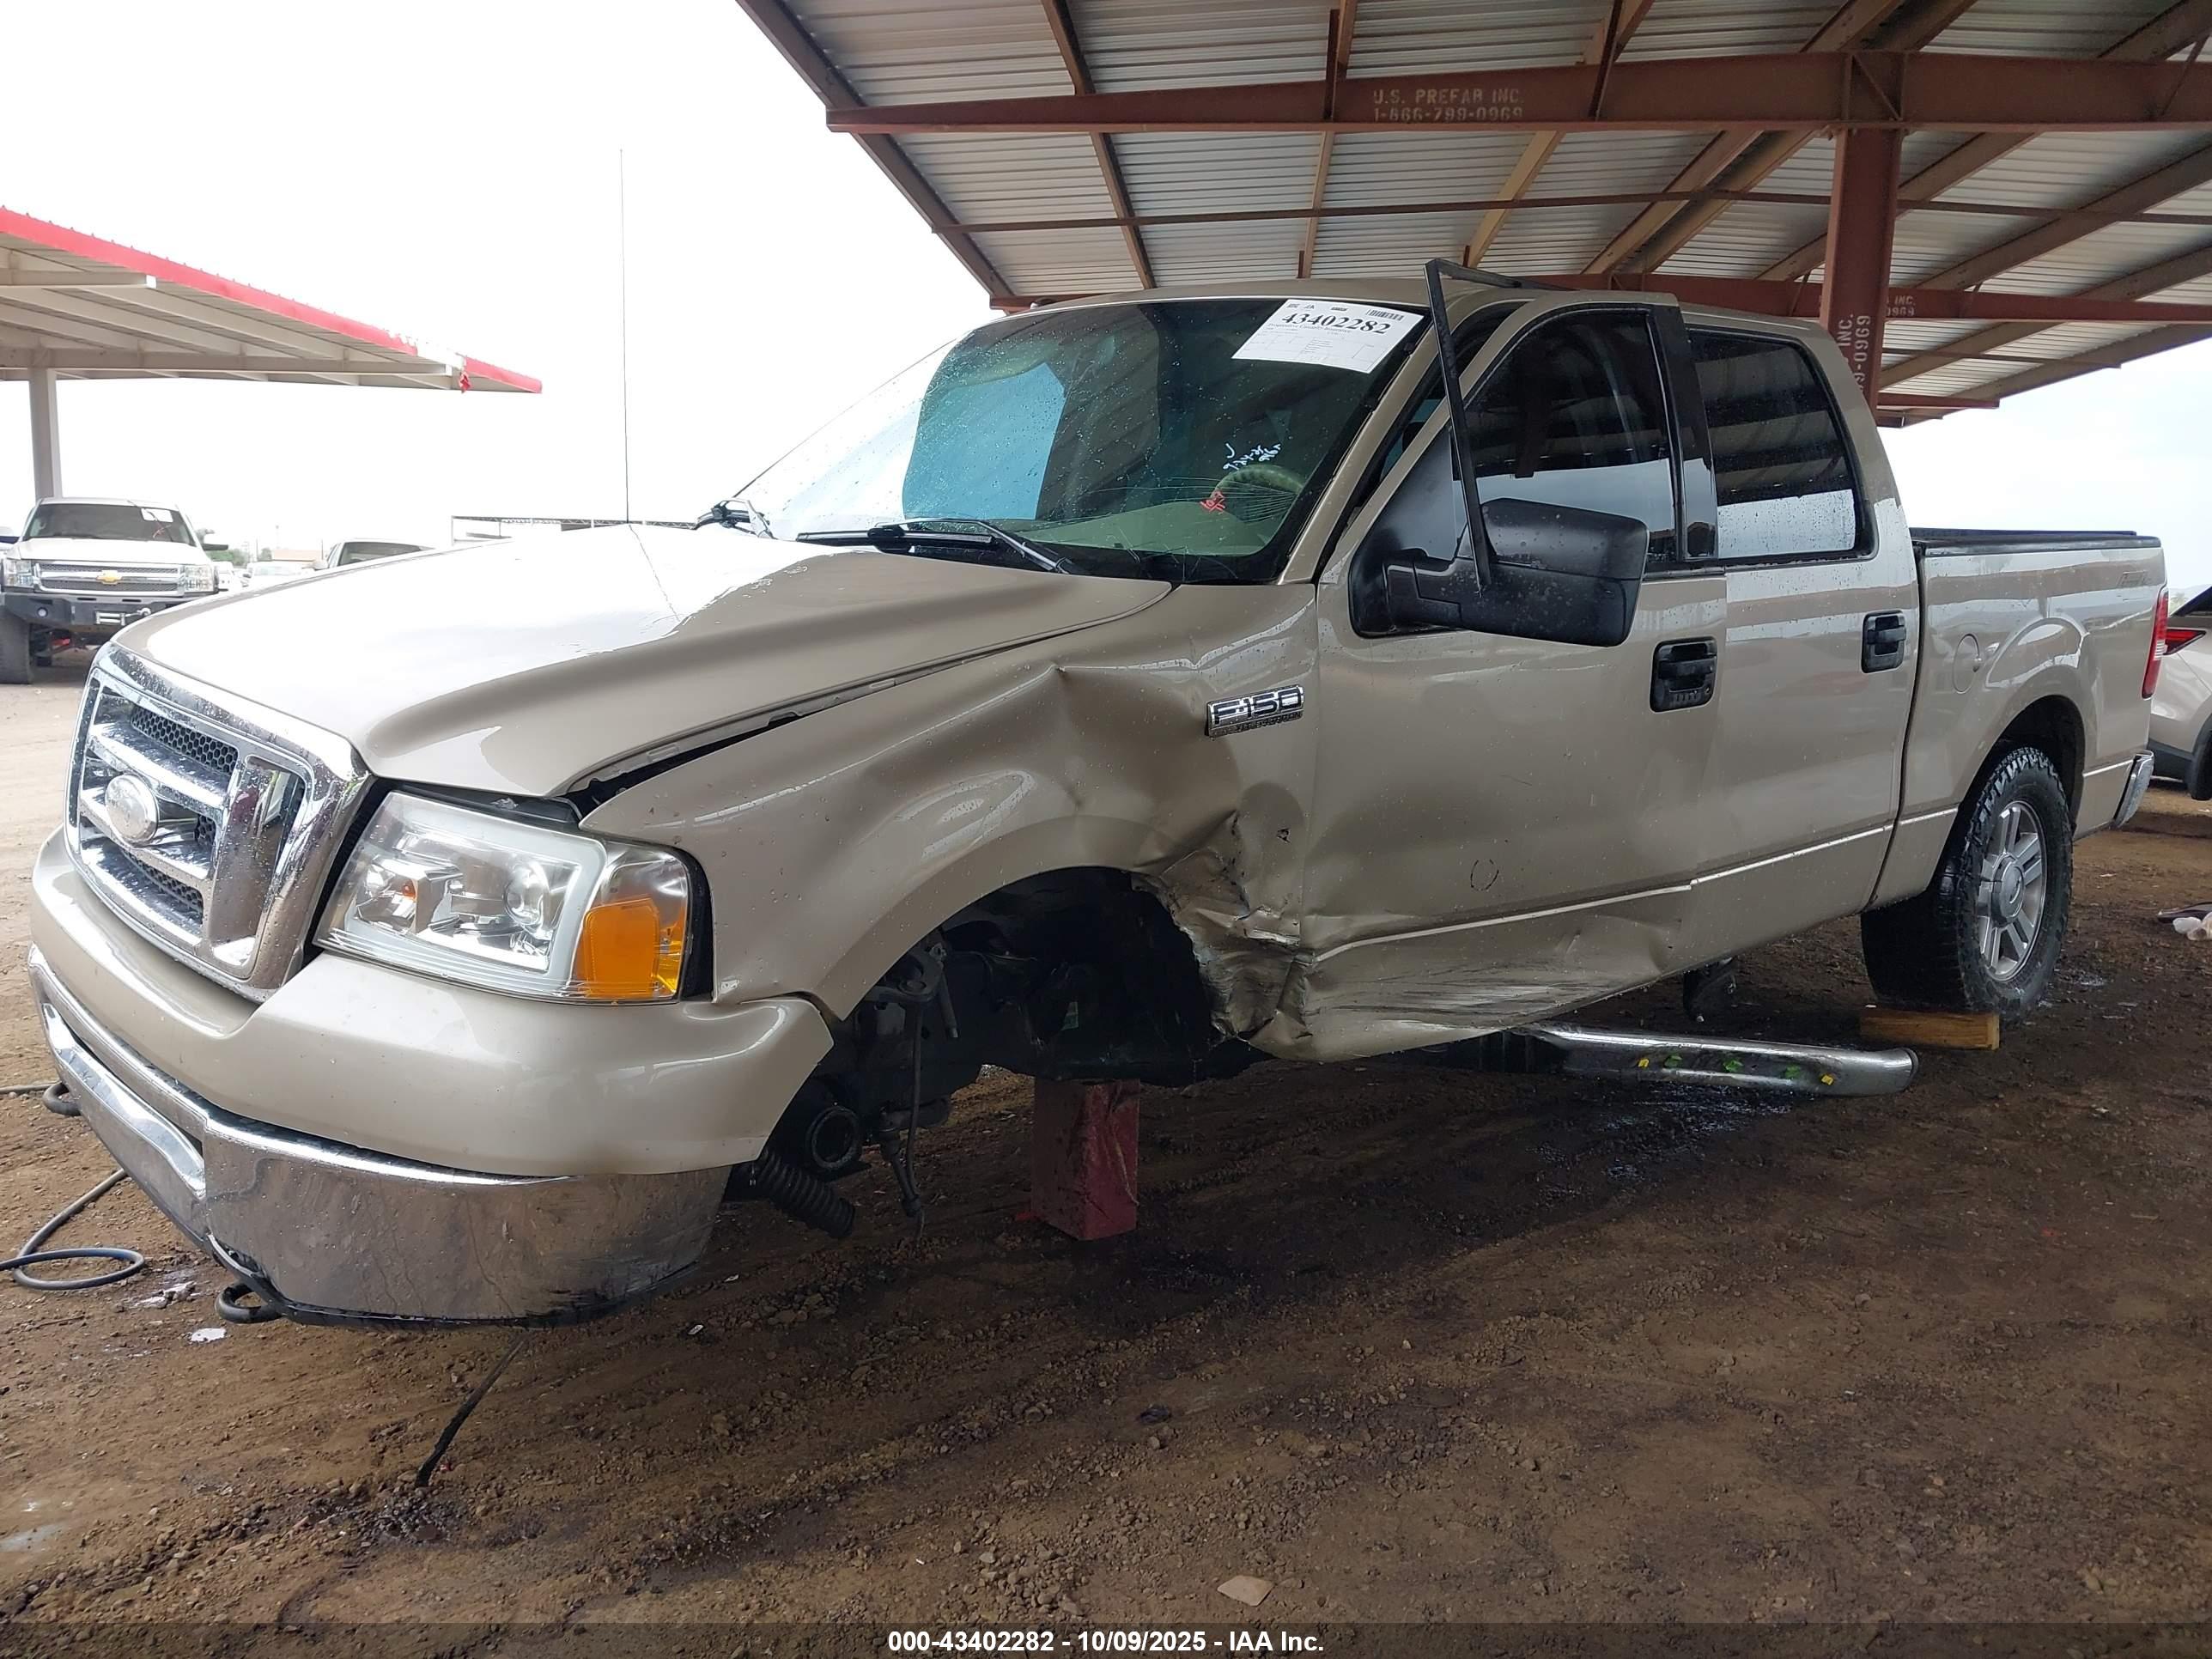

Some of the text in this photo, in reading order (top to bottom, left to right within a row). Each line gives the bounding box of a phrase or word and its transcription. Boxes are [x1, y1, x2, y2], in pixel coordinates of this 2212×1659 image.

[1374, 88, 1525, 104] U.S. PREFAB INC.
[1894, 295, 1916, 306] INC.
[1280, 312, 1392, 335] 43402282
[1838, 313, 1854, 347] INC.
[1854, 315, 1871, 390] 9-0969
